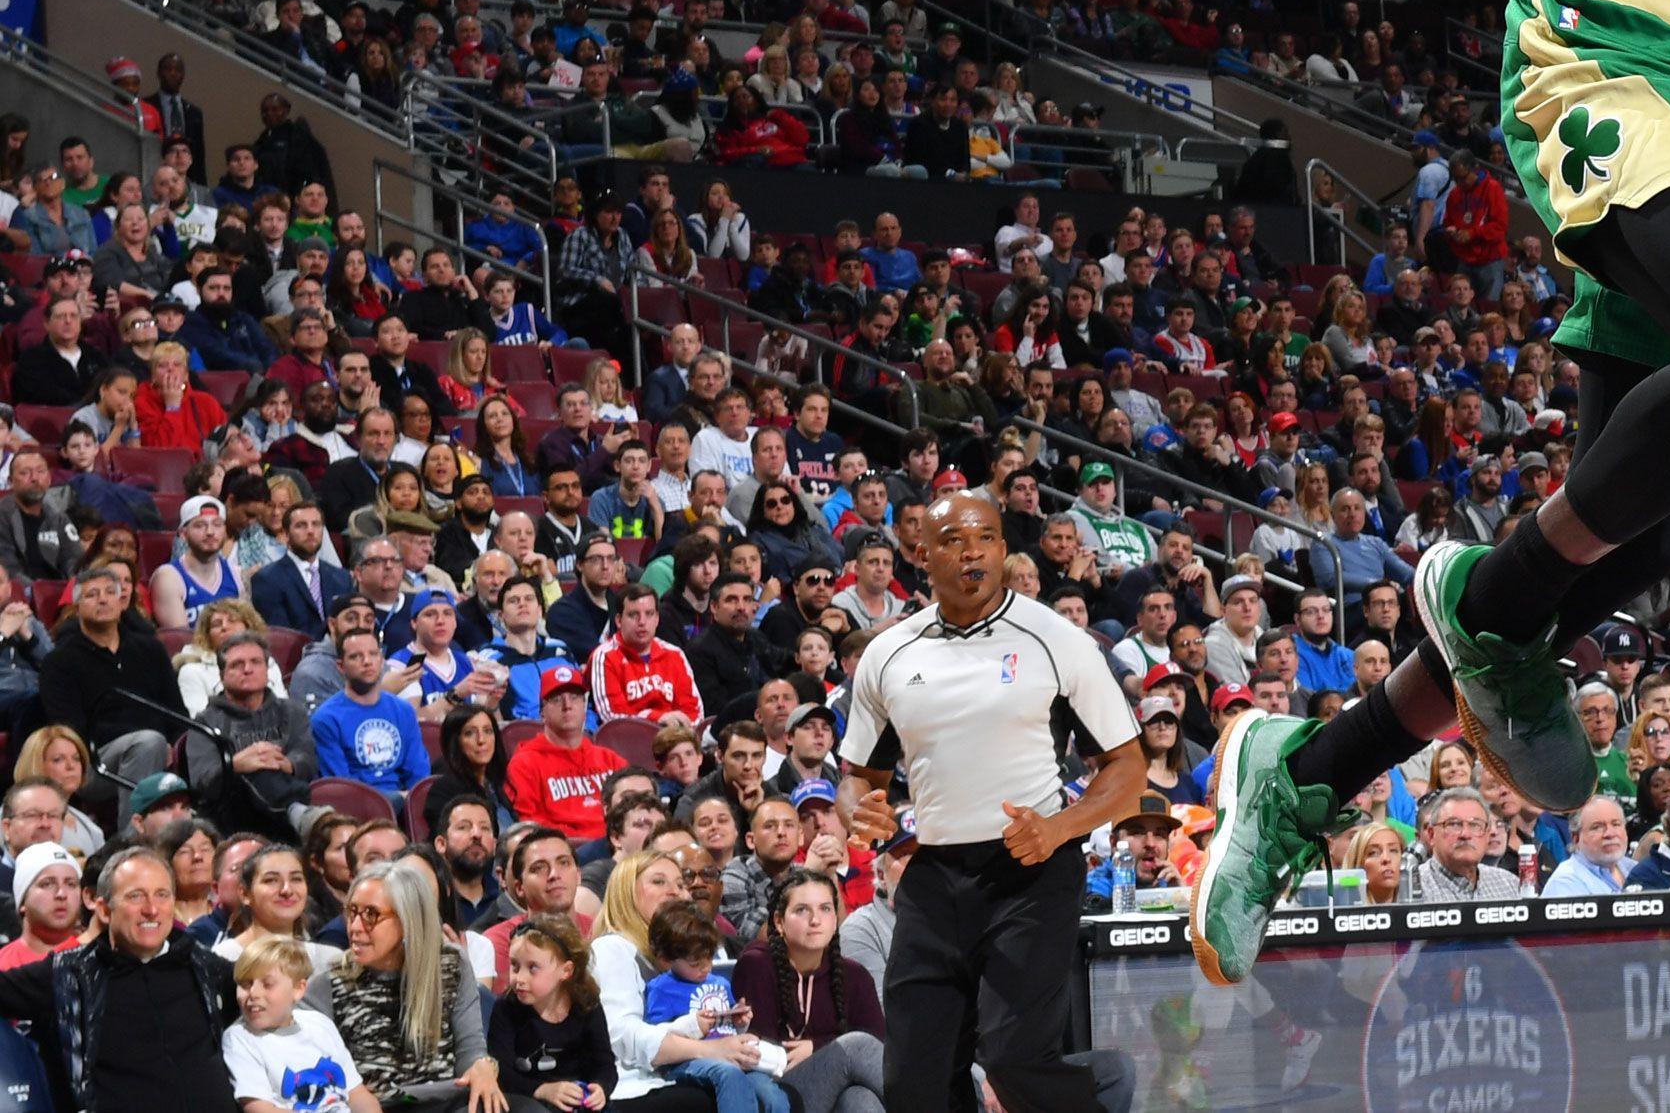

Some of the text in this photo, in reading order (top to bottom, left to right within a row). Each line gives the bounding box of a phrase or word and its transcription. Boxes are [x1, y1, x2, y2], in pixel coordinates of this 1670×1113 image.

[626, 673, 676, 703] SIXES
[548, 770, 614, 802] BUCKEY
[1109, 925, 1170, 946] GEICO
[1335, 913, 1391, 933] GEICO
[1406, 909, 1461, 928] GEICO
[1475, 905, 1529, 924] GEICO
[1545, 902, 1598, 920] GEICO
[1612, 899, 1664, 918] GEICO
[1395, 1009, 1542, 1087] SIXERS
[1427, 1084, 1515, 1113] CAMPS
